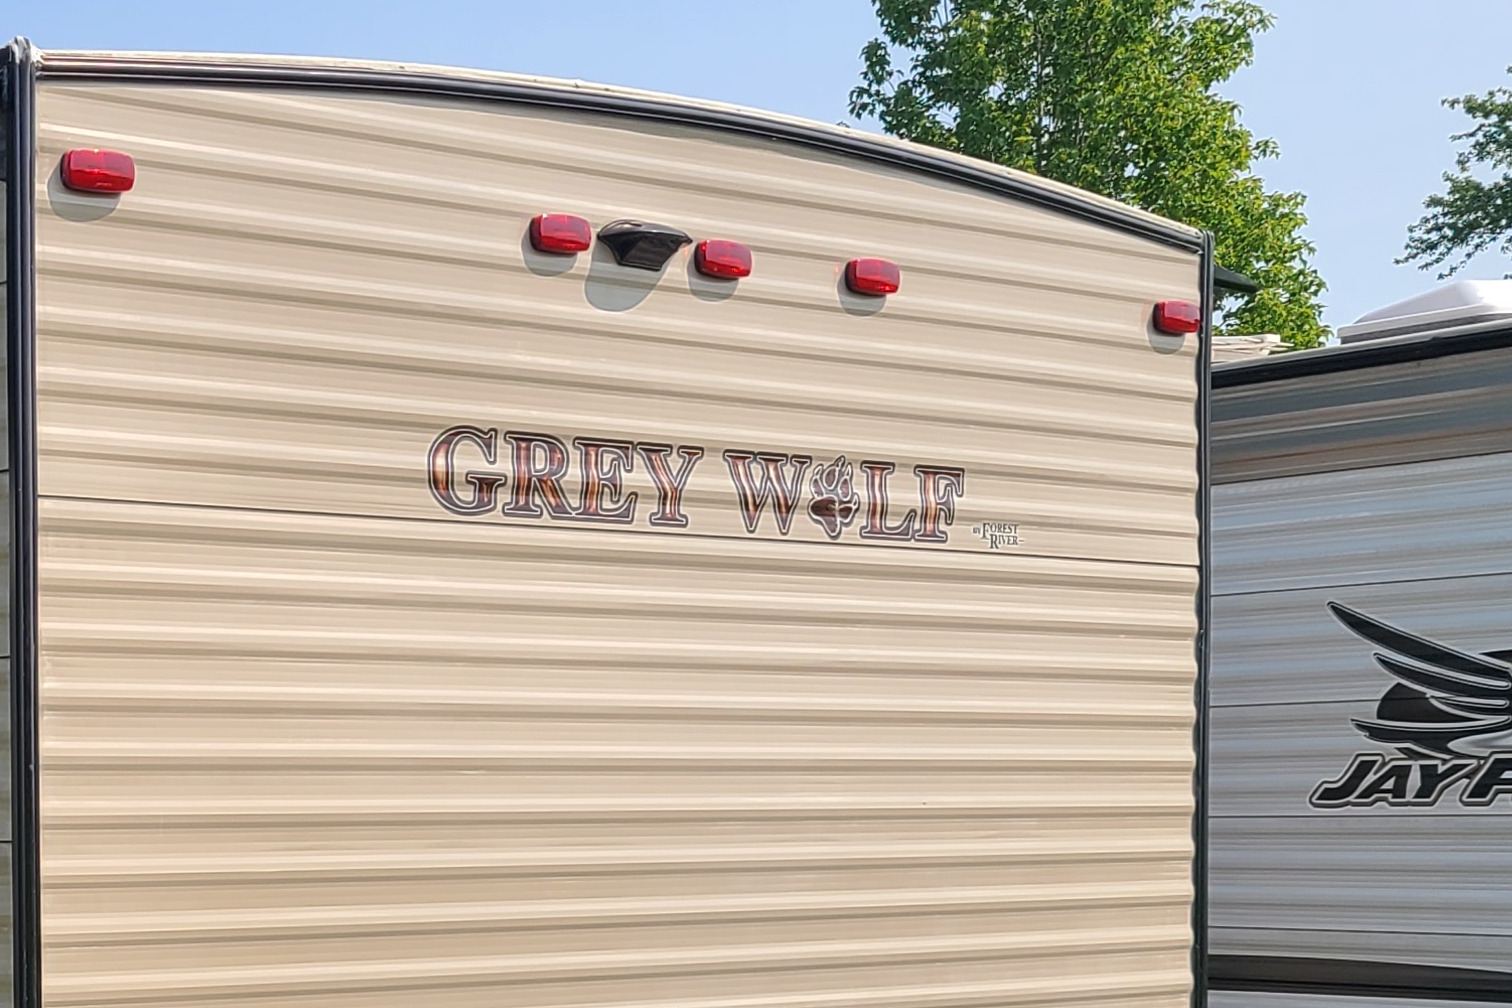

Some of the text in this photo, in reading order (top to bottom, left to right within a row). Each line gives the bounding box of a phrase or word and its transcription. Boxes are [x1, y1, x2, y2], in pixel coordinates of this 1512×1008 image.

[428, 426, 703, 527] GREY
[980, 522, 1019, 540] FOREST
[989, 534, 1019, 549] RIVER
